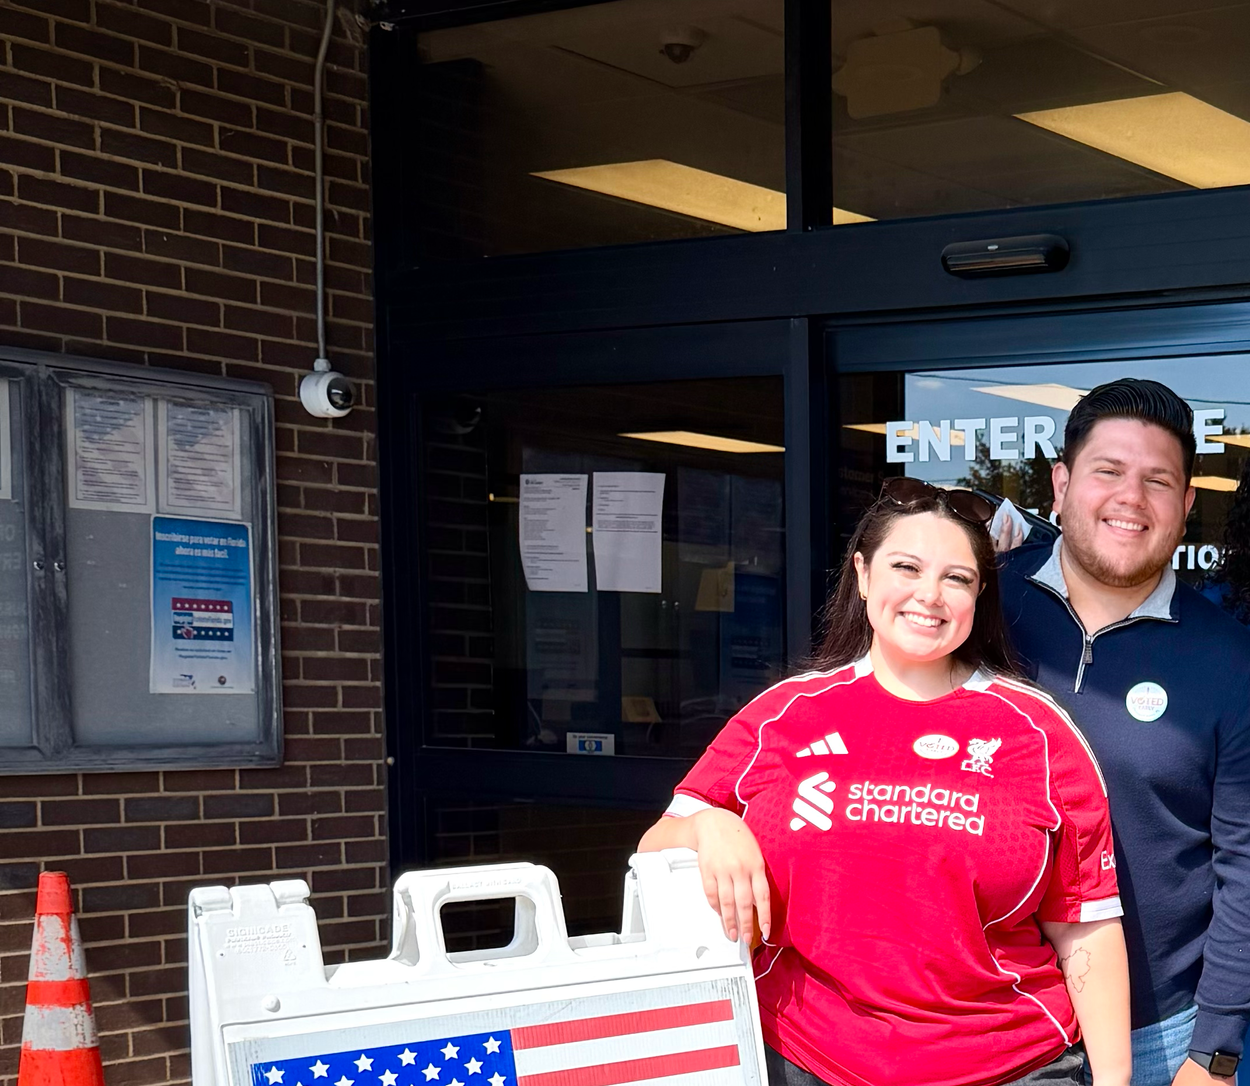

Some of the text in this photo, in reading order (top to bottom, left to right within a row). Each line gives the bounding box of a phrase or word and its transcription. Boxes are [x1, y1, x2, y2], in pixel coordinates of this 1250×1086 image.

[886, 415, 1059, 463] ENTER
[848, 781, 980, 813] standard
[845, 799, 986, 837] chartered
